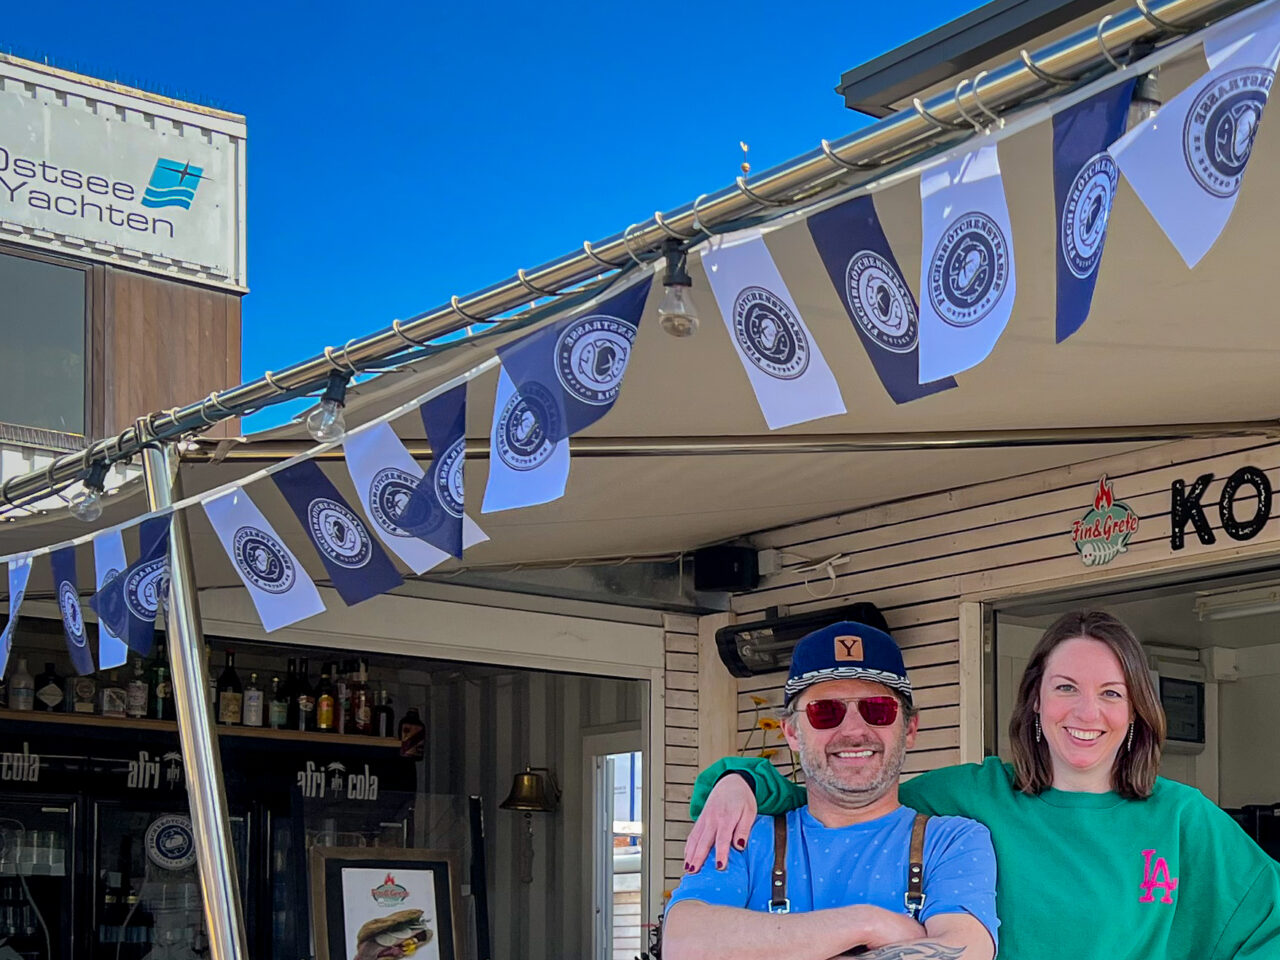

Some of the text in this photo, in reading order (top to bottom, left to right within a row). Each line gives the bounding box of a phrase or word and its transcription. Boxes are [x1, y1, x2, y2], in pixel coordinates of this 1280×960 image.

[0, 176, 174, 238] Yachten
[1072, 511, 1139, 542] Fin&Grete
[838, 639, 858, 657] Y
[1, 742, 40, 782] cola
[127, 751, 161, 789] afri
[297, 761, 326, 798] afri
[347, 764, 378, 800] cola
[1139, 849, 1179, 904] LA
